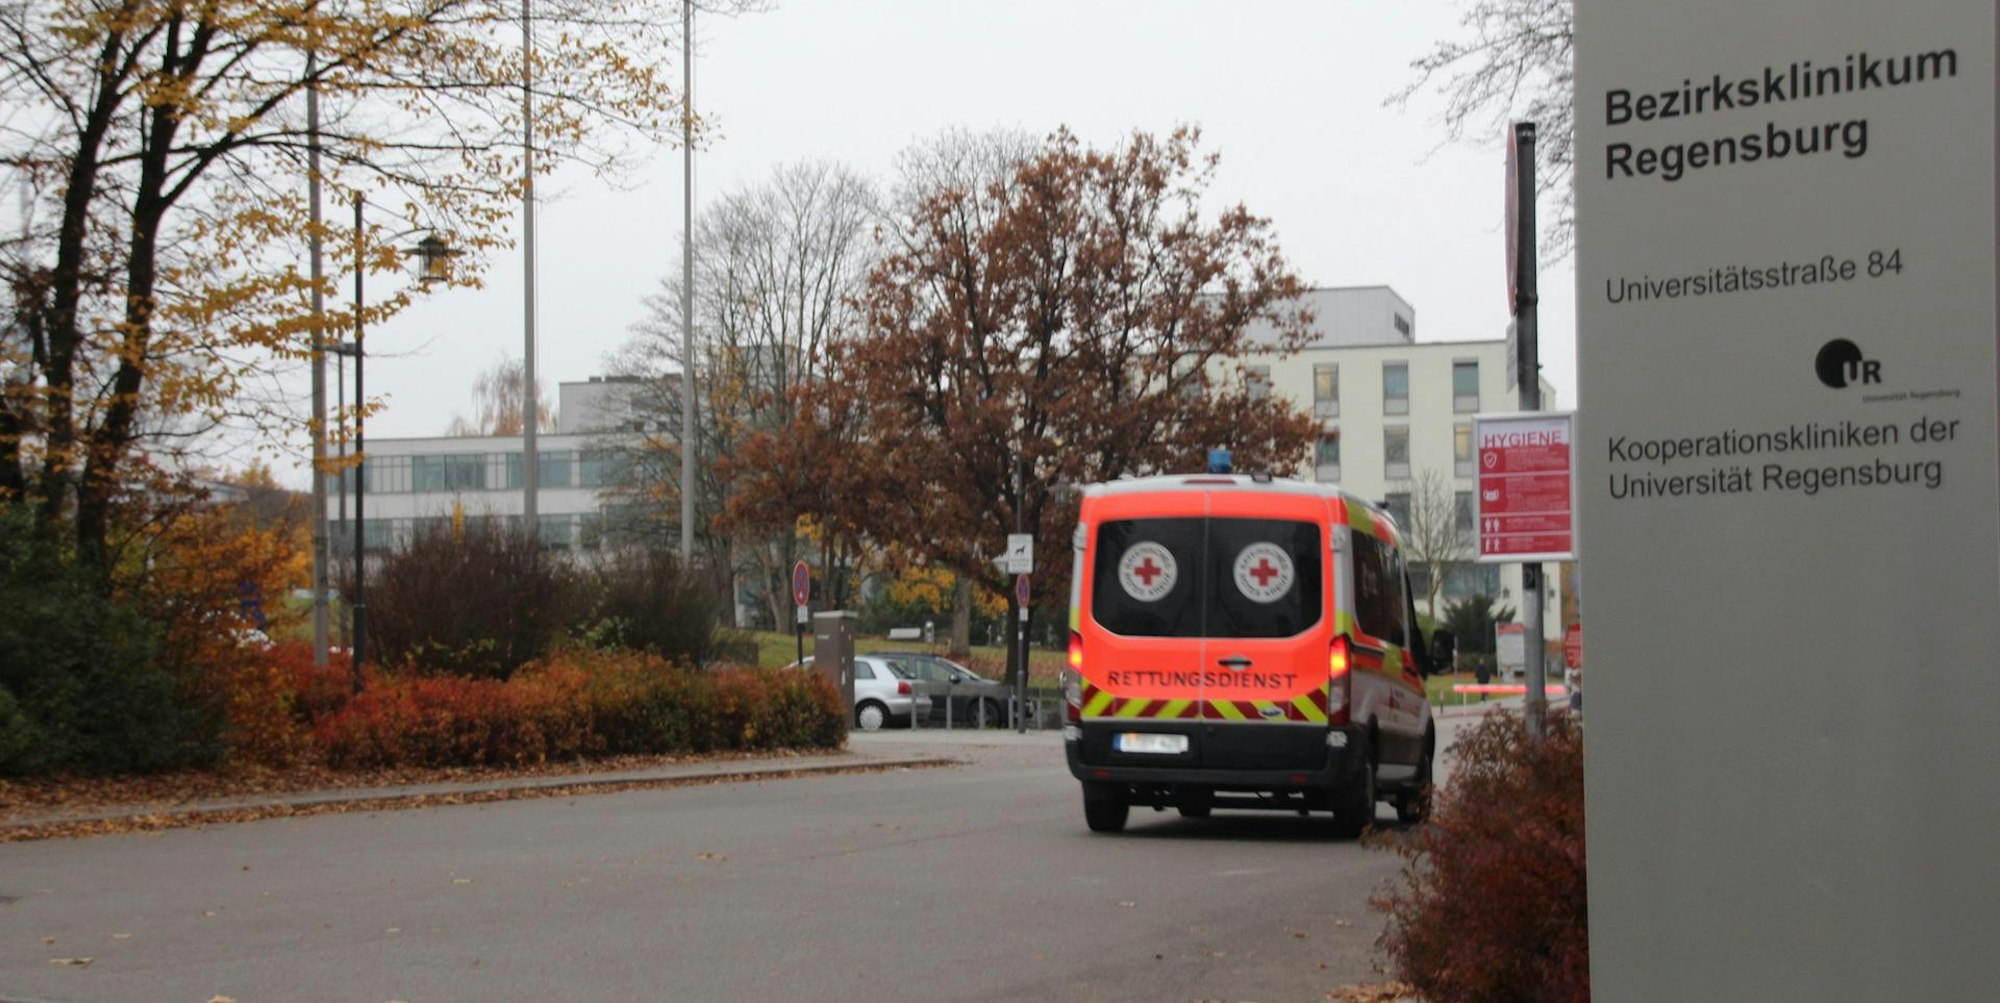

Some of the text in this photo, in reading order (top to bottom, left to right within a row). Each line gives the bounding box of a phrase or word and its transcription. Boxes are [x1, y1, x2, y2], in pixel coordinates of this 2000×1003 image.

[1605, 47, 1958, 127] Bezirksklinikum
[1605, 118, 1869, 182] Regensburg
[1606, 248, 1904, 304] Universitätsstraße 84
[1484, 430, 1562, 449] HYGIENE
[1608, 420, 1899, 466] Kooperationskliniken
[1909, 415, 1961, 444] der
[1609, 466, 1753, 500] Universität
[1762, 457, 1942, 496] Regensburg
[1107, 670, 1297, 689] RETTUNGSDIENST
